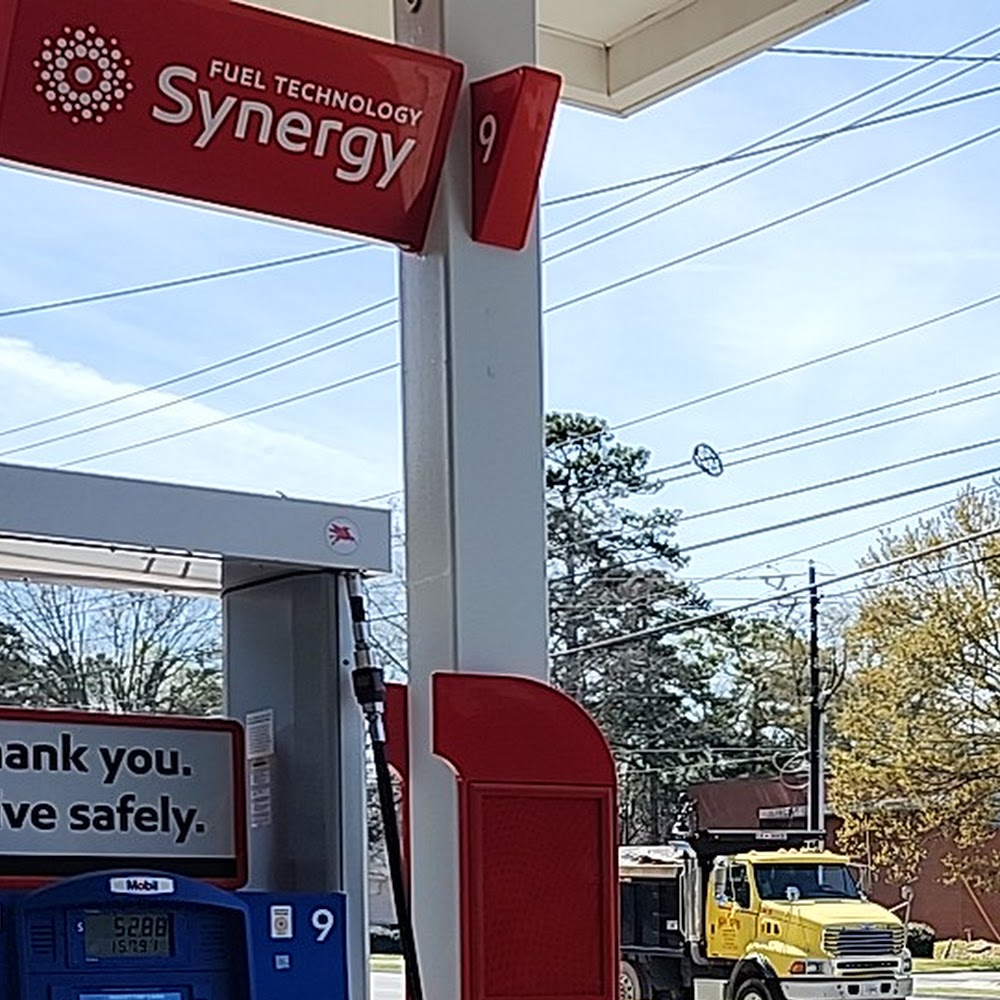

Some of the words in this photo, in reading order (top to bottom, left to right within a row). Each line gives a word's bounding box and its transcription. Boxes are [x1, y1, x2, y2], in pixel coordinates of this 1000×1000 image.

[209, 59, 266, 90] FUEL
[275, 75, 424, 128] TECHNOLOGY
[152, 65, 417, 190] Synergy
[478, 115, 497, 164] 9
[101, 747, 193, 785] you.
[0, 803, 57, 830] ve
[70, 795, 206, 844] safely.
[126, 879, 159, 891] Mobil
[311, 908, 335, 942] 9
